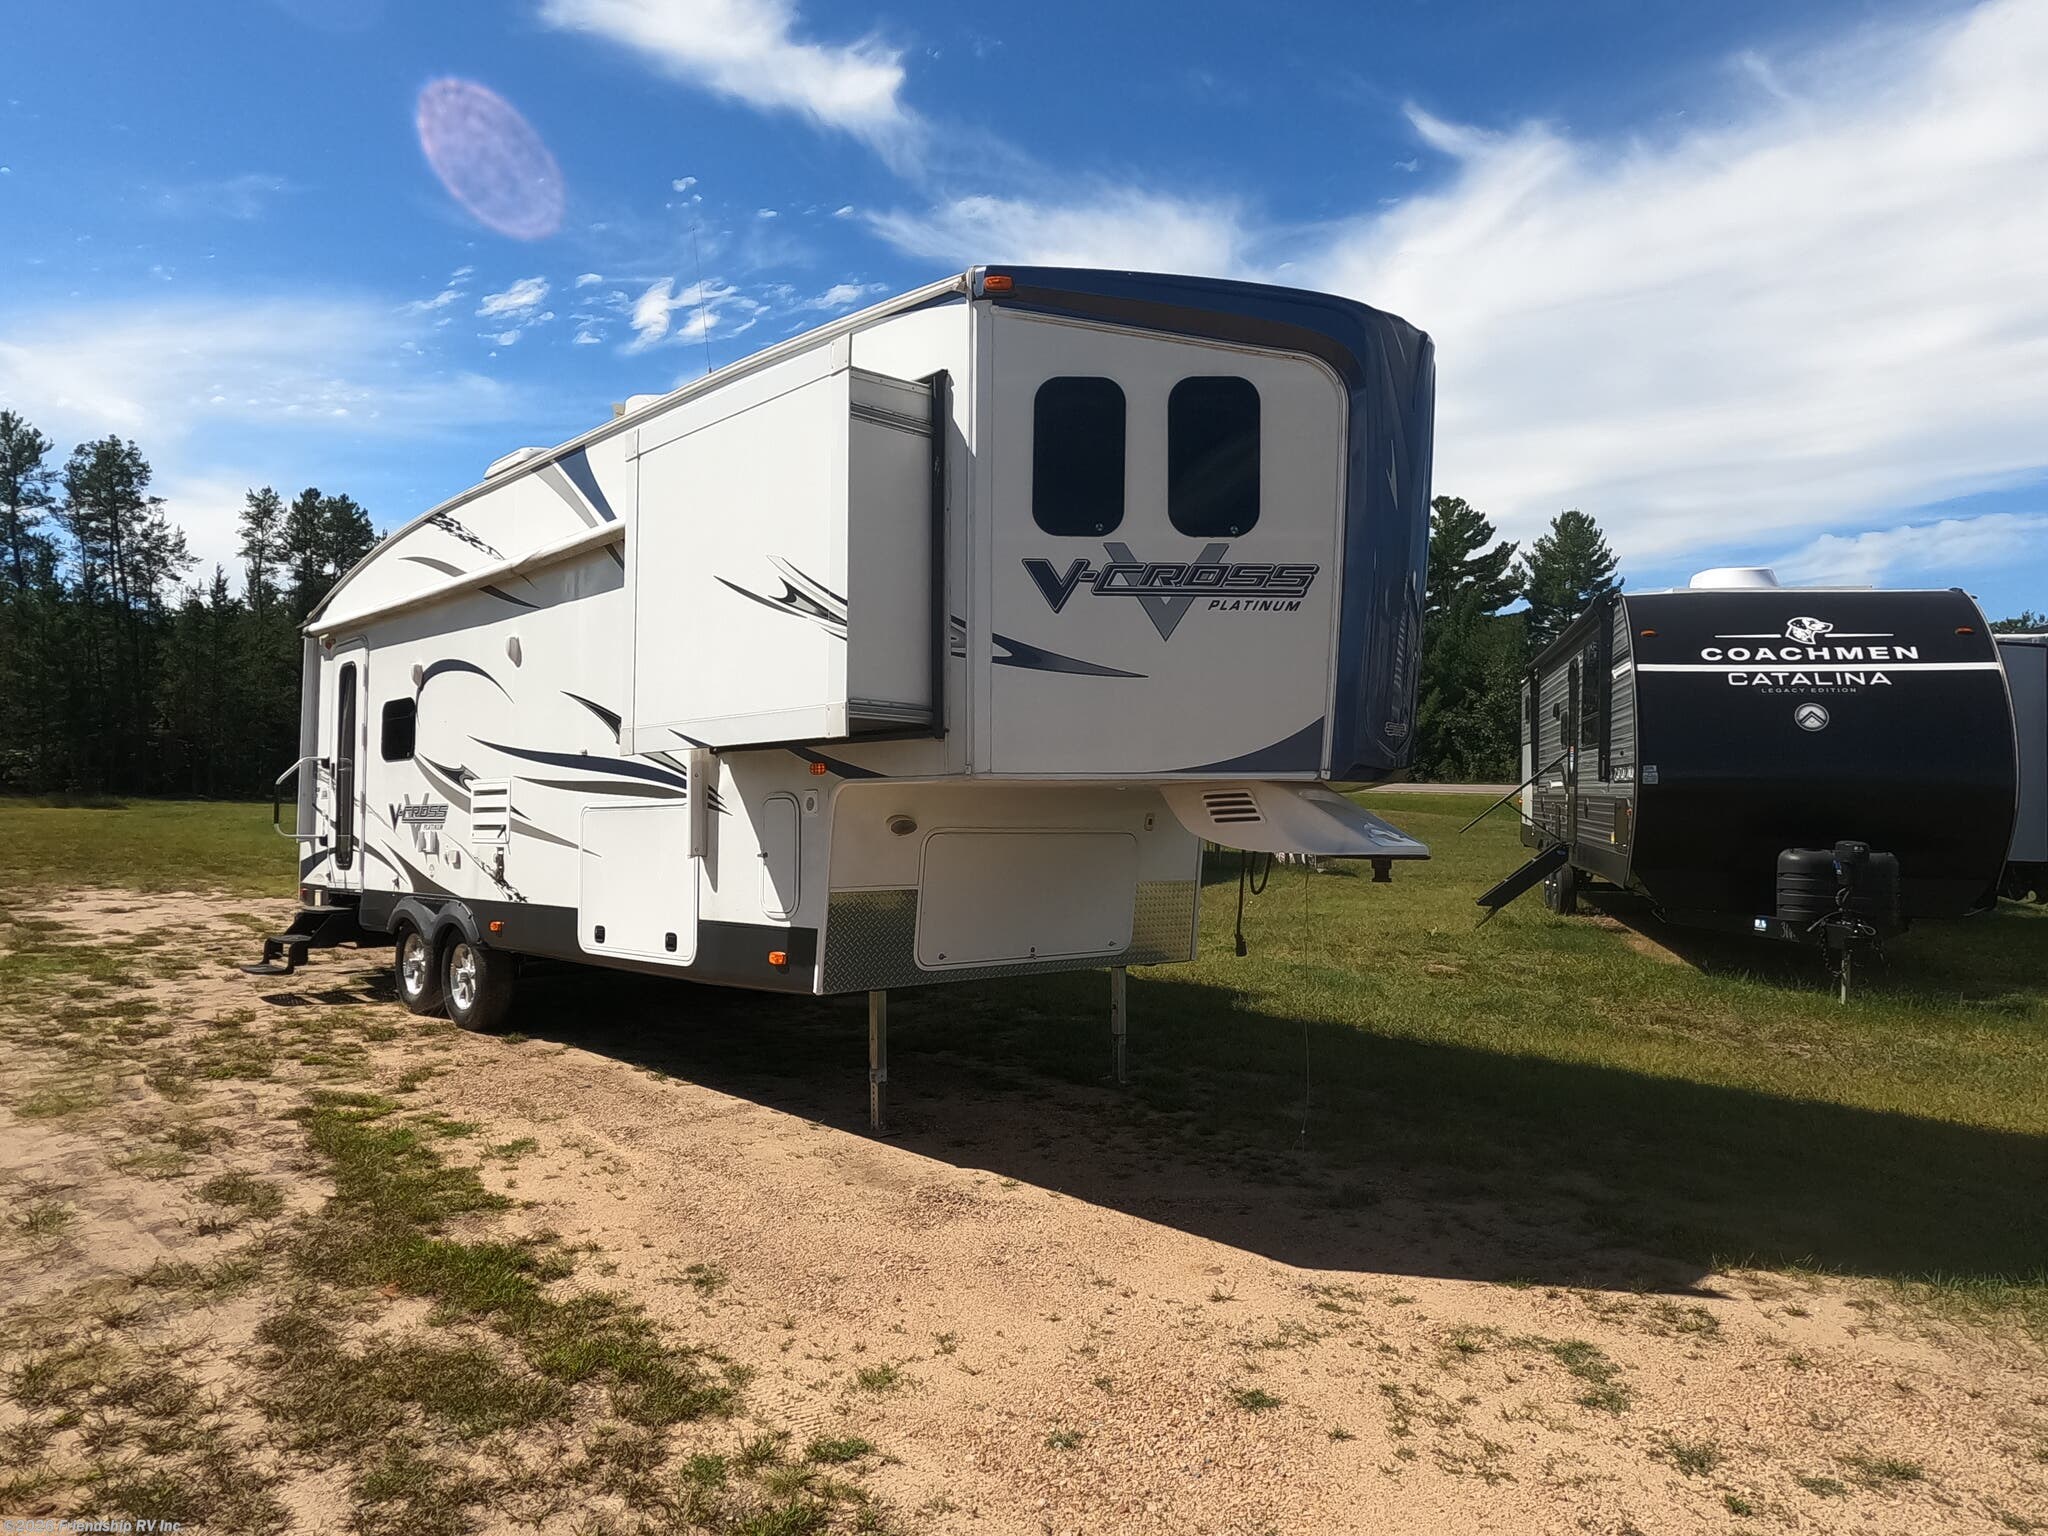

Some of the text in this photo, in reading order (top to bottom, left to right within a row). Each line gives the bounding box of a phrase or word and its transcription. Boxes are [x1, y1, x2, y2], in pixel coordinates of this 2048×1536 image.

[1021, 558, 1320, 615] V-CROSS
[1207, 599, 1302, 613] PLATINUM
[1700, 646, 1920, 661] COACHMEN
[1727, 671, 1893, 686] CATALINA
[1810, 686, 1858, 694] EDITION
